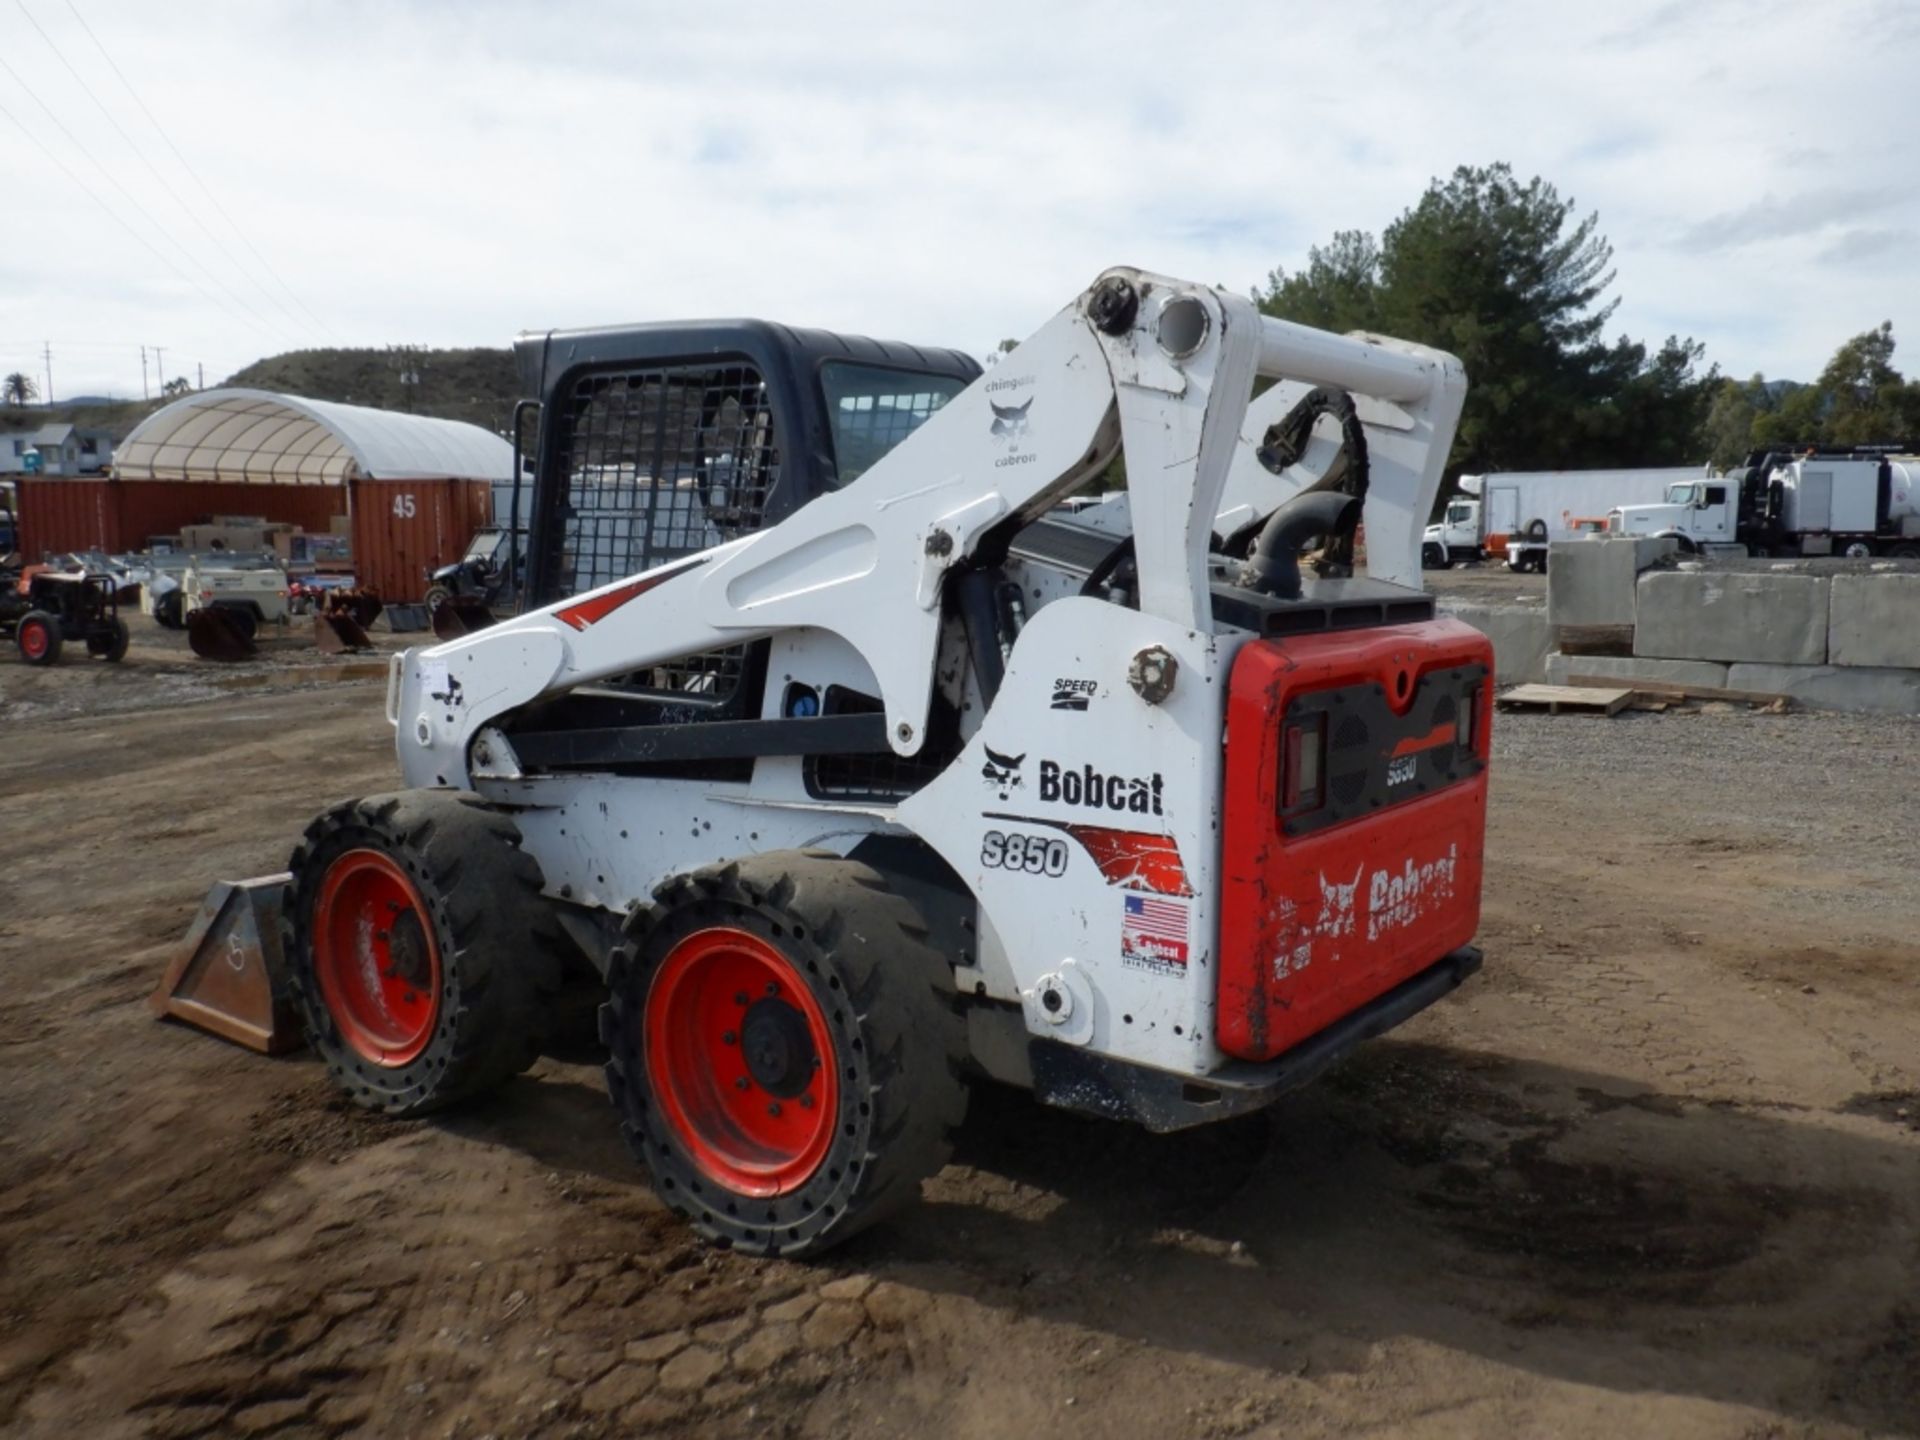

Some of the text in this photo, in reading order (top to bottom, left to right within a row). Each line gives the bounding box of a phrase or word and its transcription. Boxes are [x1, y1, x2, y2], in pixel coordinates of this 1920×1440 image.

[393, 494, 416, 518] 45
[1054, 678, 1098, 694] SPEED
[1040, 760, 1164, 817] Bobcat
[981, 830, 1069, 878] S850
